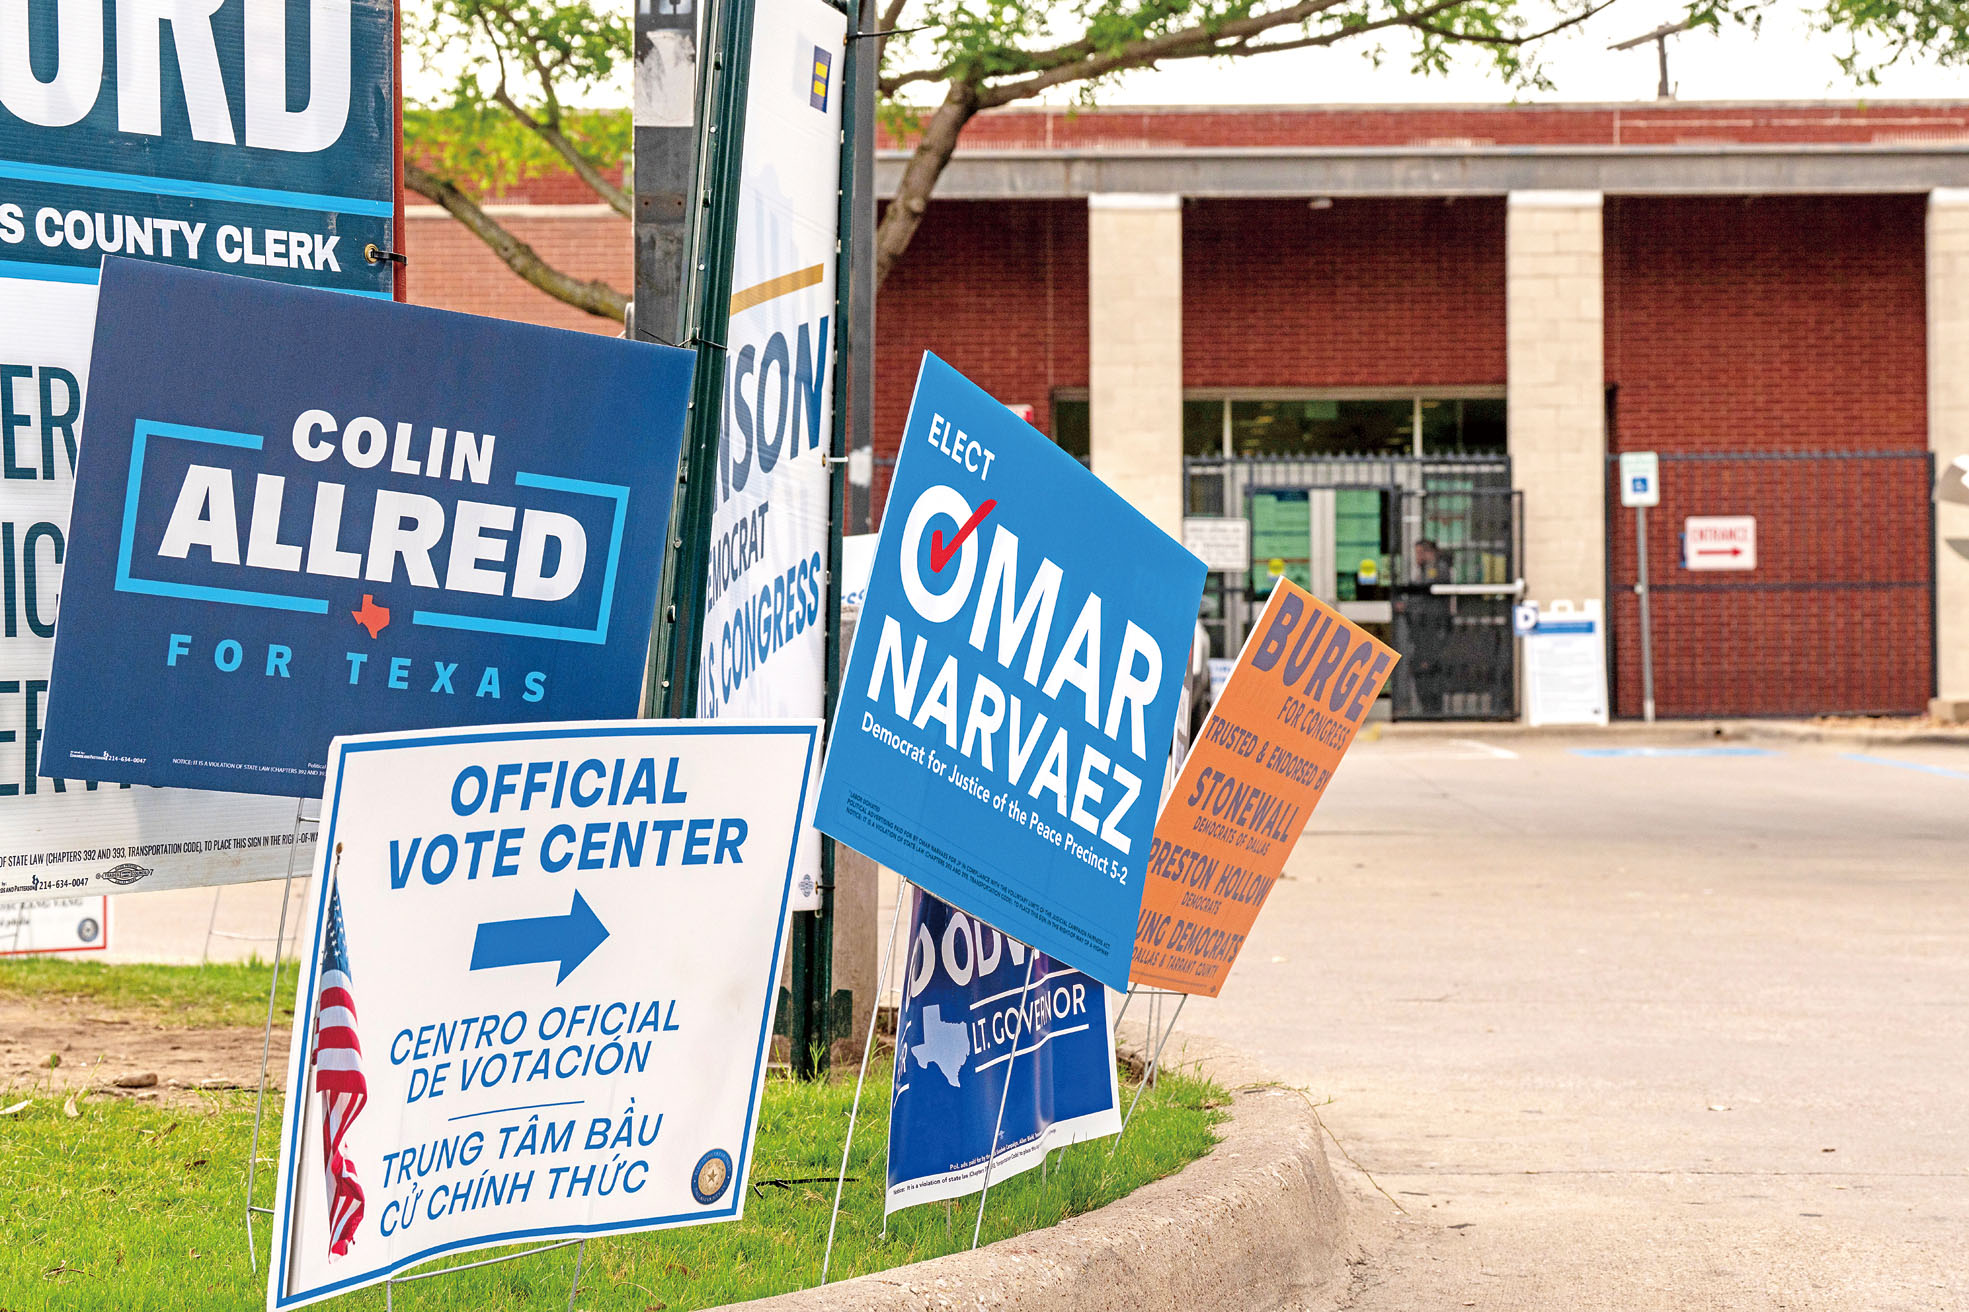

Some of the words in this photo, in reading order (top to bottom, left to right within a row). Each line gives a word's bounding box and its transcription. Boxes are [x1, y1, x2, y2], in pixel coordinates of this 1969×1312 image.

[35, 207, 206, 259] COUNTY
[216, 225, 341, 272] CLERK
[292, 409, 496, 484] COLIN
[927, 412, 995, 481] ELECT
[157, 464, 587, 601] ALLRED
[721, 551, 821, 704] CONGRESS
[900, 485, 1163, 762] OMAR
[1251, 591, 1390, 723] BURGE
[167, 633, 293, 678] FOR
[346, 652, 547, 703] TEXAS
[866, 614, 1143, 856] NARVAEZ
[1205, 714, 1259, 758] TRUSTED
[1256, 740, 1270, 763] &
[1266, 746, 1318, 787] ENDORSED
[1314, 769, 1333, 792] BY
[1277, 696, 1305, 728] FOR
[1300, 708, 1351, 750] CONGRESS
[208, 761, 235, 769] VIOLATION
[450, 757, 687, 816] OFFICIAL
[861, 711, 925, 767] Democrat
[927, 749, 947, 778] for
[947, 763, 990, 802] Justice
[993, 791, 1007, 813] of
[1008, 800, 1028, 826] the
[1029, 810, 1063, 847] Peace
[1064, 832, 1108, 876] Precinct
[1110, 859, 1128, 886] 5-2
[1187, 766, 1300, 843] STONEWALL
[1193, 816, 1237, 845] DEMOCRATS
[1235, 833, 1248, 847] OF
[1245, 837, 1271, 857] DALLAS
[8, 855, 28, 867] STATE
[29, 853, 44, 865] LAW
[45, 850, 82, 866] (CHAPTERS
[83, 850, 97, 862] 392
[97, 848, 111, 860] AND
[112, 847, 127, 859] 393,
[128, 842, 182, 858] TRANSPORTATION
[204, 840, 212, 852] TO
[213, 838, 232, 851] PLACE
[233, 837, 247, 849] THIS
[248, 836, 262, 848] SIGN
[263, 835, 269, 847] IN
[270, 834, 281, 846] THE
[39, 878, 88, 890] 214-634-0047
[388, 827, 526, 890] VOTE
[539, 818, 749, 873] CENTER
[1147, 837, 1219, 892] PRESTON
[1213, 864, 1274, 907] HOLLOW
[1180, 891, 1222, 915] DEMOCRATS
[1131, 946, 1160, 966] DALLAS
[1166, 955, 1197, 975] TARRANT
[1195, 962, 1219, 979] COUNTY
[1166, 919, 1244, 963] DEMOCRATS
[389, 1010, 528, 1066] CENTRO
[538, 1000, 680, 1041] OFICIAL
[972, 1017, 990, 1055] LT.
[992, 984, 1086, 1045] GOVERNOR
[407, 1062, 450, 1104] DE
[459, 1034, 651, 1091] VOTACIÓN
[382, 1131, 485, 1188] TRUNG
[498, 1114, 577, 1160] TÂM
[584, 1096, 664, 1150] BẦU
[380, 1181, 428, 1238] CỬ
[426, 1168, 535, 1221] CHÍNH
[547, 1153, 650, 1200] THỨC
[919, 1179, 940, 1187] violation
